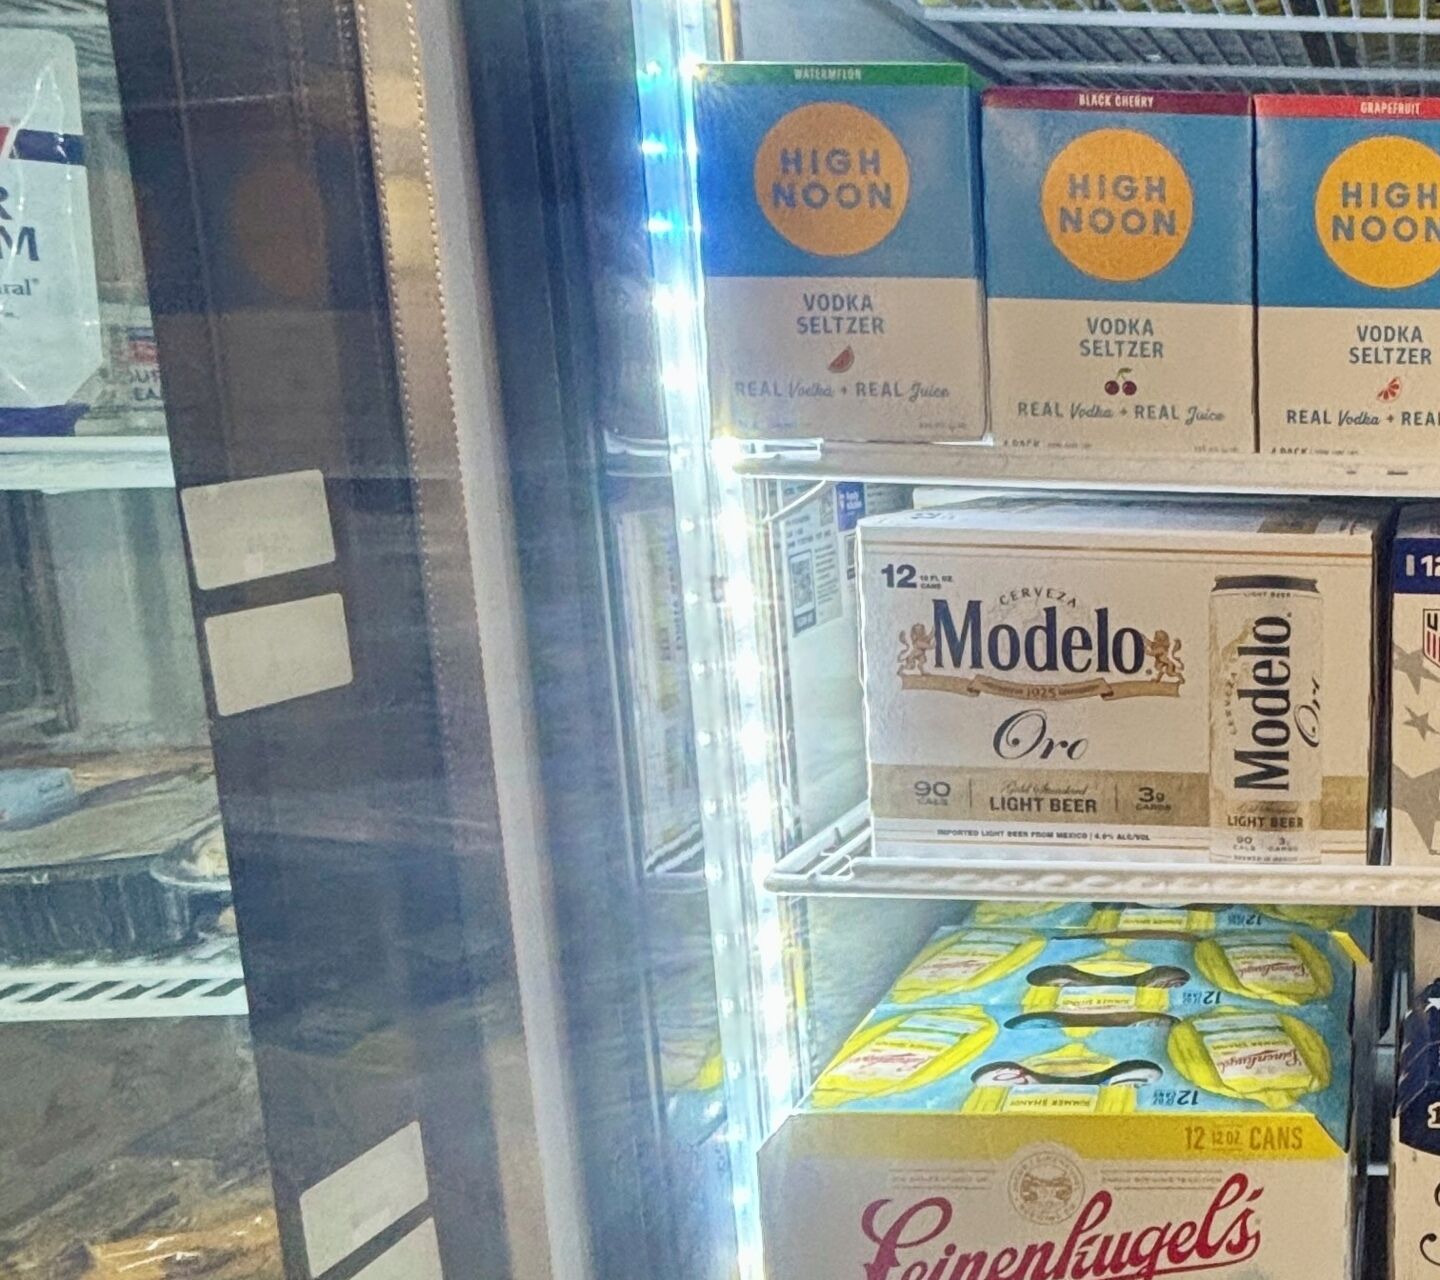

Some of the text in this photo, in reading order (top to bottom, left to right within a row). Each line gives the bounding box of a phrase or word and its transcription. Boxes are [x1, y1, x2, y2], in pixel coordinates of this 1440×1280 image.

[1078, 94, 1154, 108] BLACK CHERRY
[1360, 102, 1421, 115] GRAPEFRUIT
[781, 148, 882, 174] HIGH
[771, 182, 893, 209] NOON
[1068, 173, 1167, 202] HIGH
[1341, 181, 1438, 210] HIGH
[1058, 207, 1177, 236] NOON
[803, 293, 874, 311] VODKA
[796, 316, 885, 335] SELTZER
[1086, 317, 1154, 335] VODKA
[1356, 325, 1422, 343] VODKA
[1079, 339, 1164, 358] SELTZER
[1348, 346, 1432, 365] SELTZER
[1018, 401, 1225, 425] REAL Vodka REAL Juice
[1286, 409, 1332, 426] REAL
[1337, 409, 1380, 427] Vodka
[881, 564, 917, 589] 12
[1000, 587, 1077, 608] CERVEZA
[932, 599, 1146, 675] Modelo
[1026, 686, 1057, 699] 1925
[1233, 615, 1291, 791] Modelo
[992, 709, 1089, 761] Oro
[914, 780, 951, 798] 90
[1137, 786, 1165, 803] 3g
[989, 796, 1097, 814] LIGHT BEER
[1227, 815, 1304, 828] LIGHT BEER
[1205, 991, 1222, 1005] 12
[1177, 1090, 1199, 1106] 12
[1185, 1126, 1303, 1151] 12 12 OZ CANS
